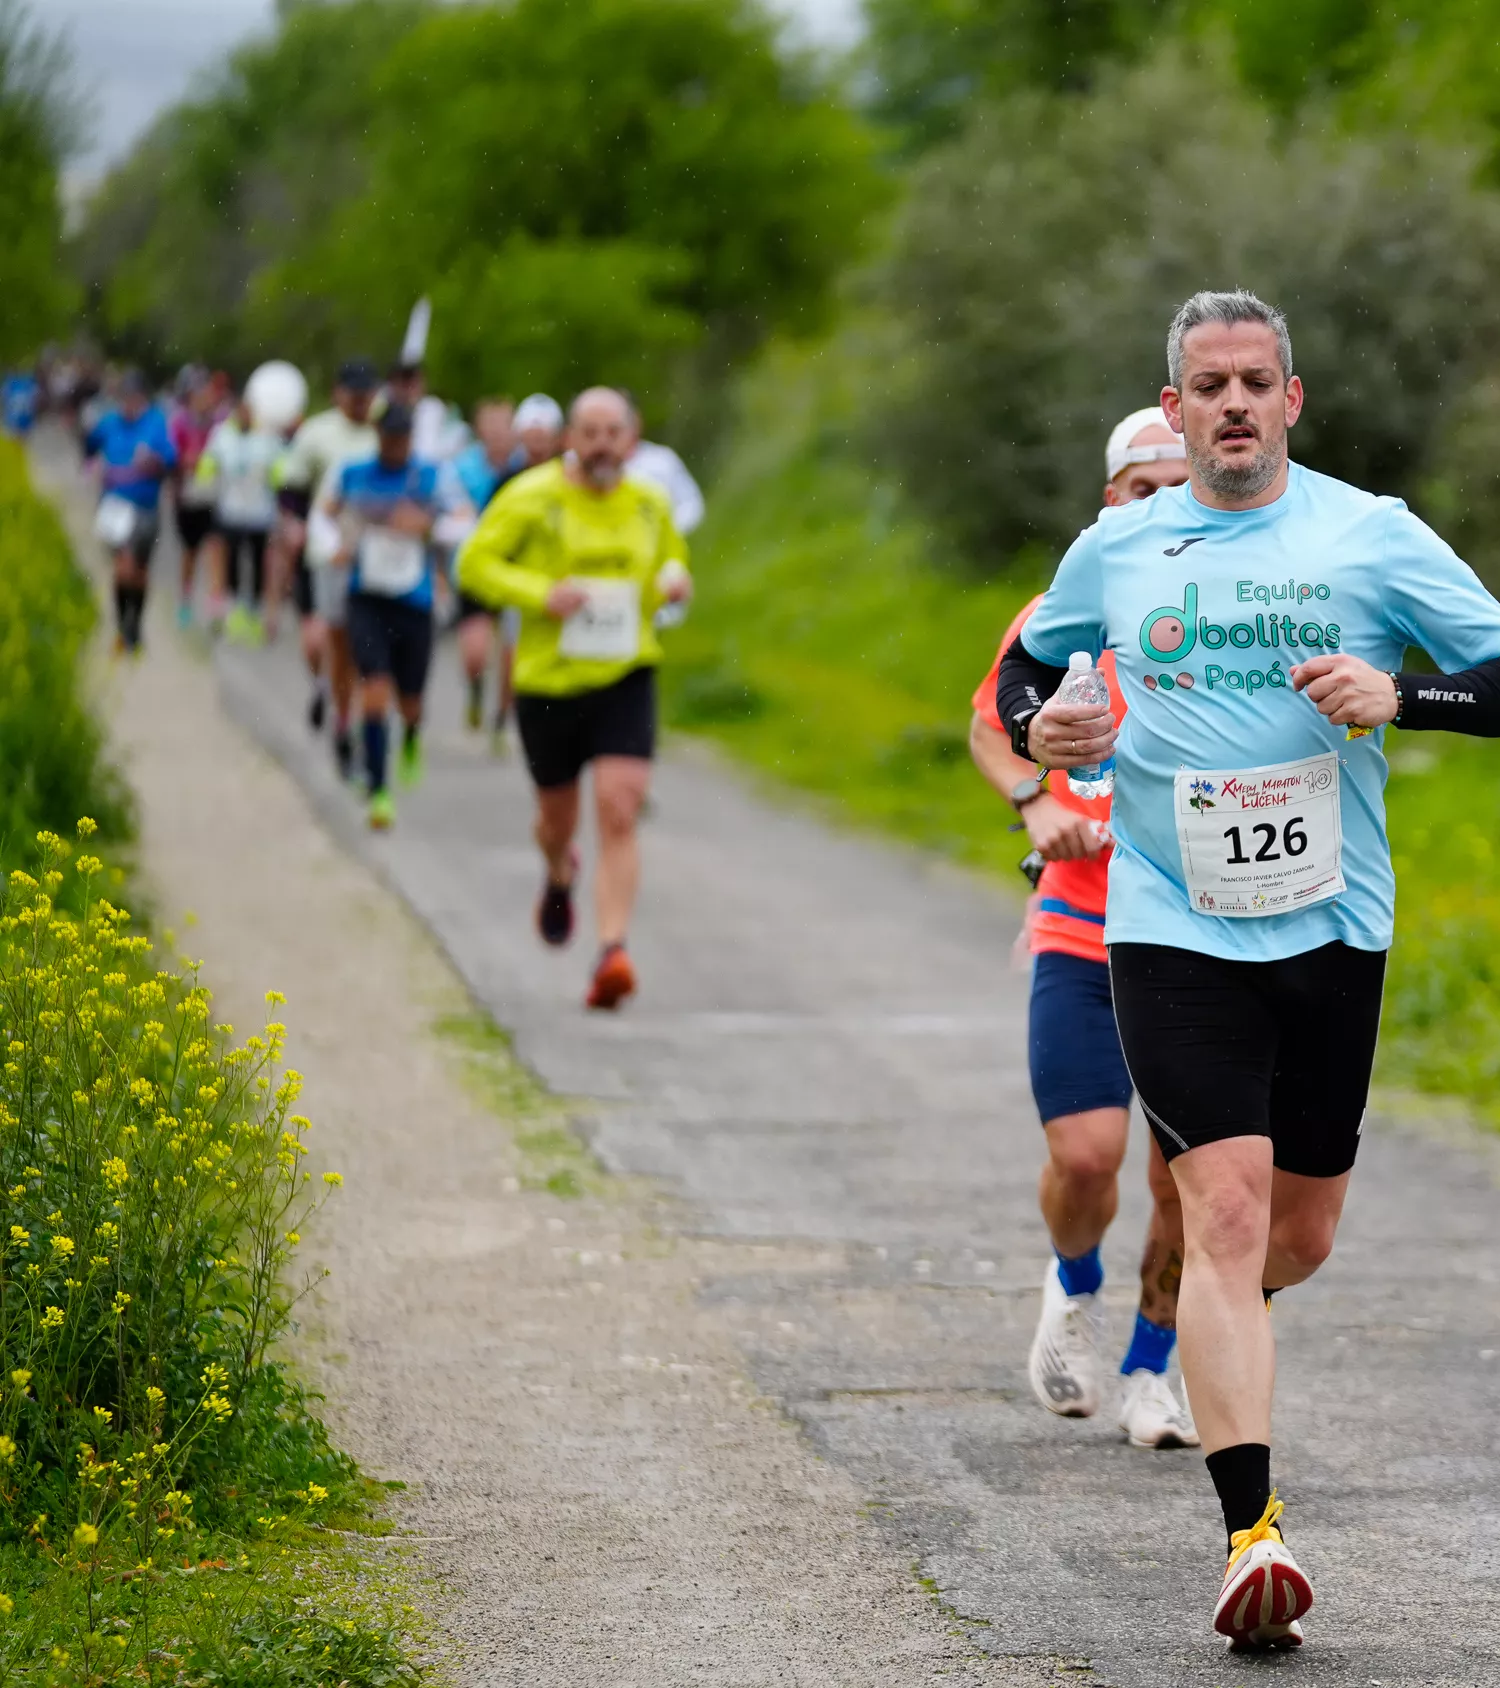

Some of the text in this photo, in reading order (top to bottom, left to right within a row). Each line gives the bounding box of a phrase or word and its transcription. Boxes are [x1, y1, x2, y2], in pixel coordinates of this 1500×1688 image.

[1236, 578, 1331, 605] Equipo
[1204, 660, 1286, 695] Papá
[1417, 687, 1476, 703] MÍTICAL
[1262, 775, 1302, 790] MARATÓN
[1242, 791, 1293, 809] LUCENA
[1223, 817, 1308, 864] 126
[1253, 873, 1273, 882] JAVIER
[1274, 870, 1292, 880] CALVO
[1292, 864, 1315, 875] ZAMORA
